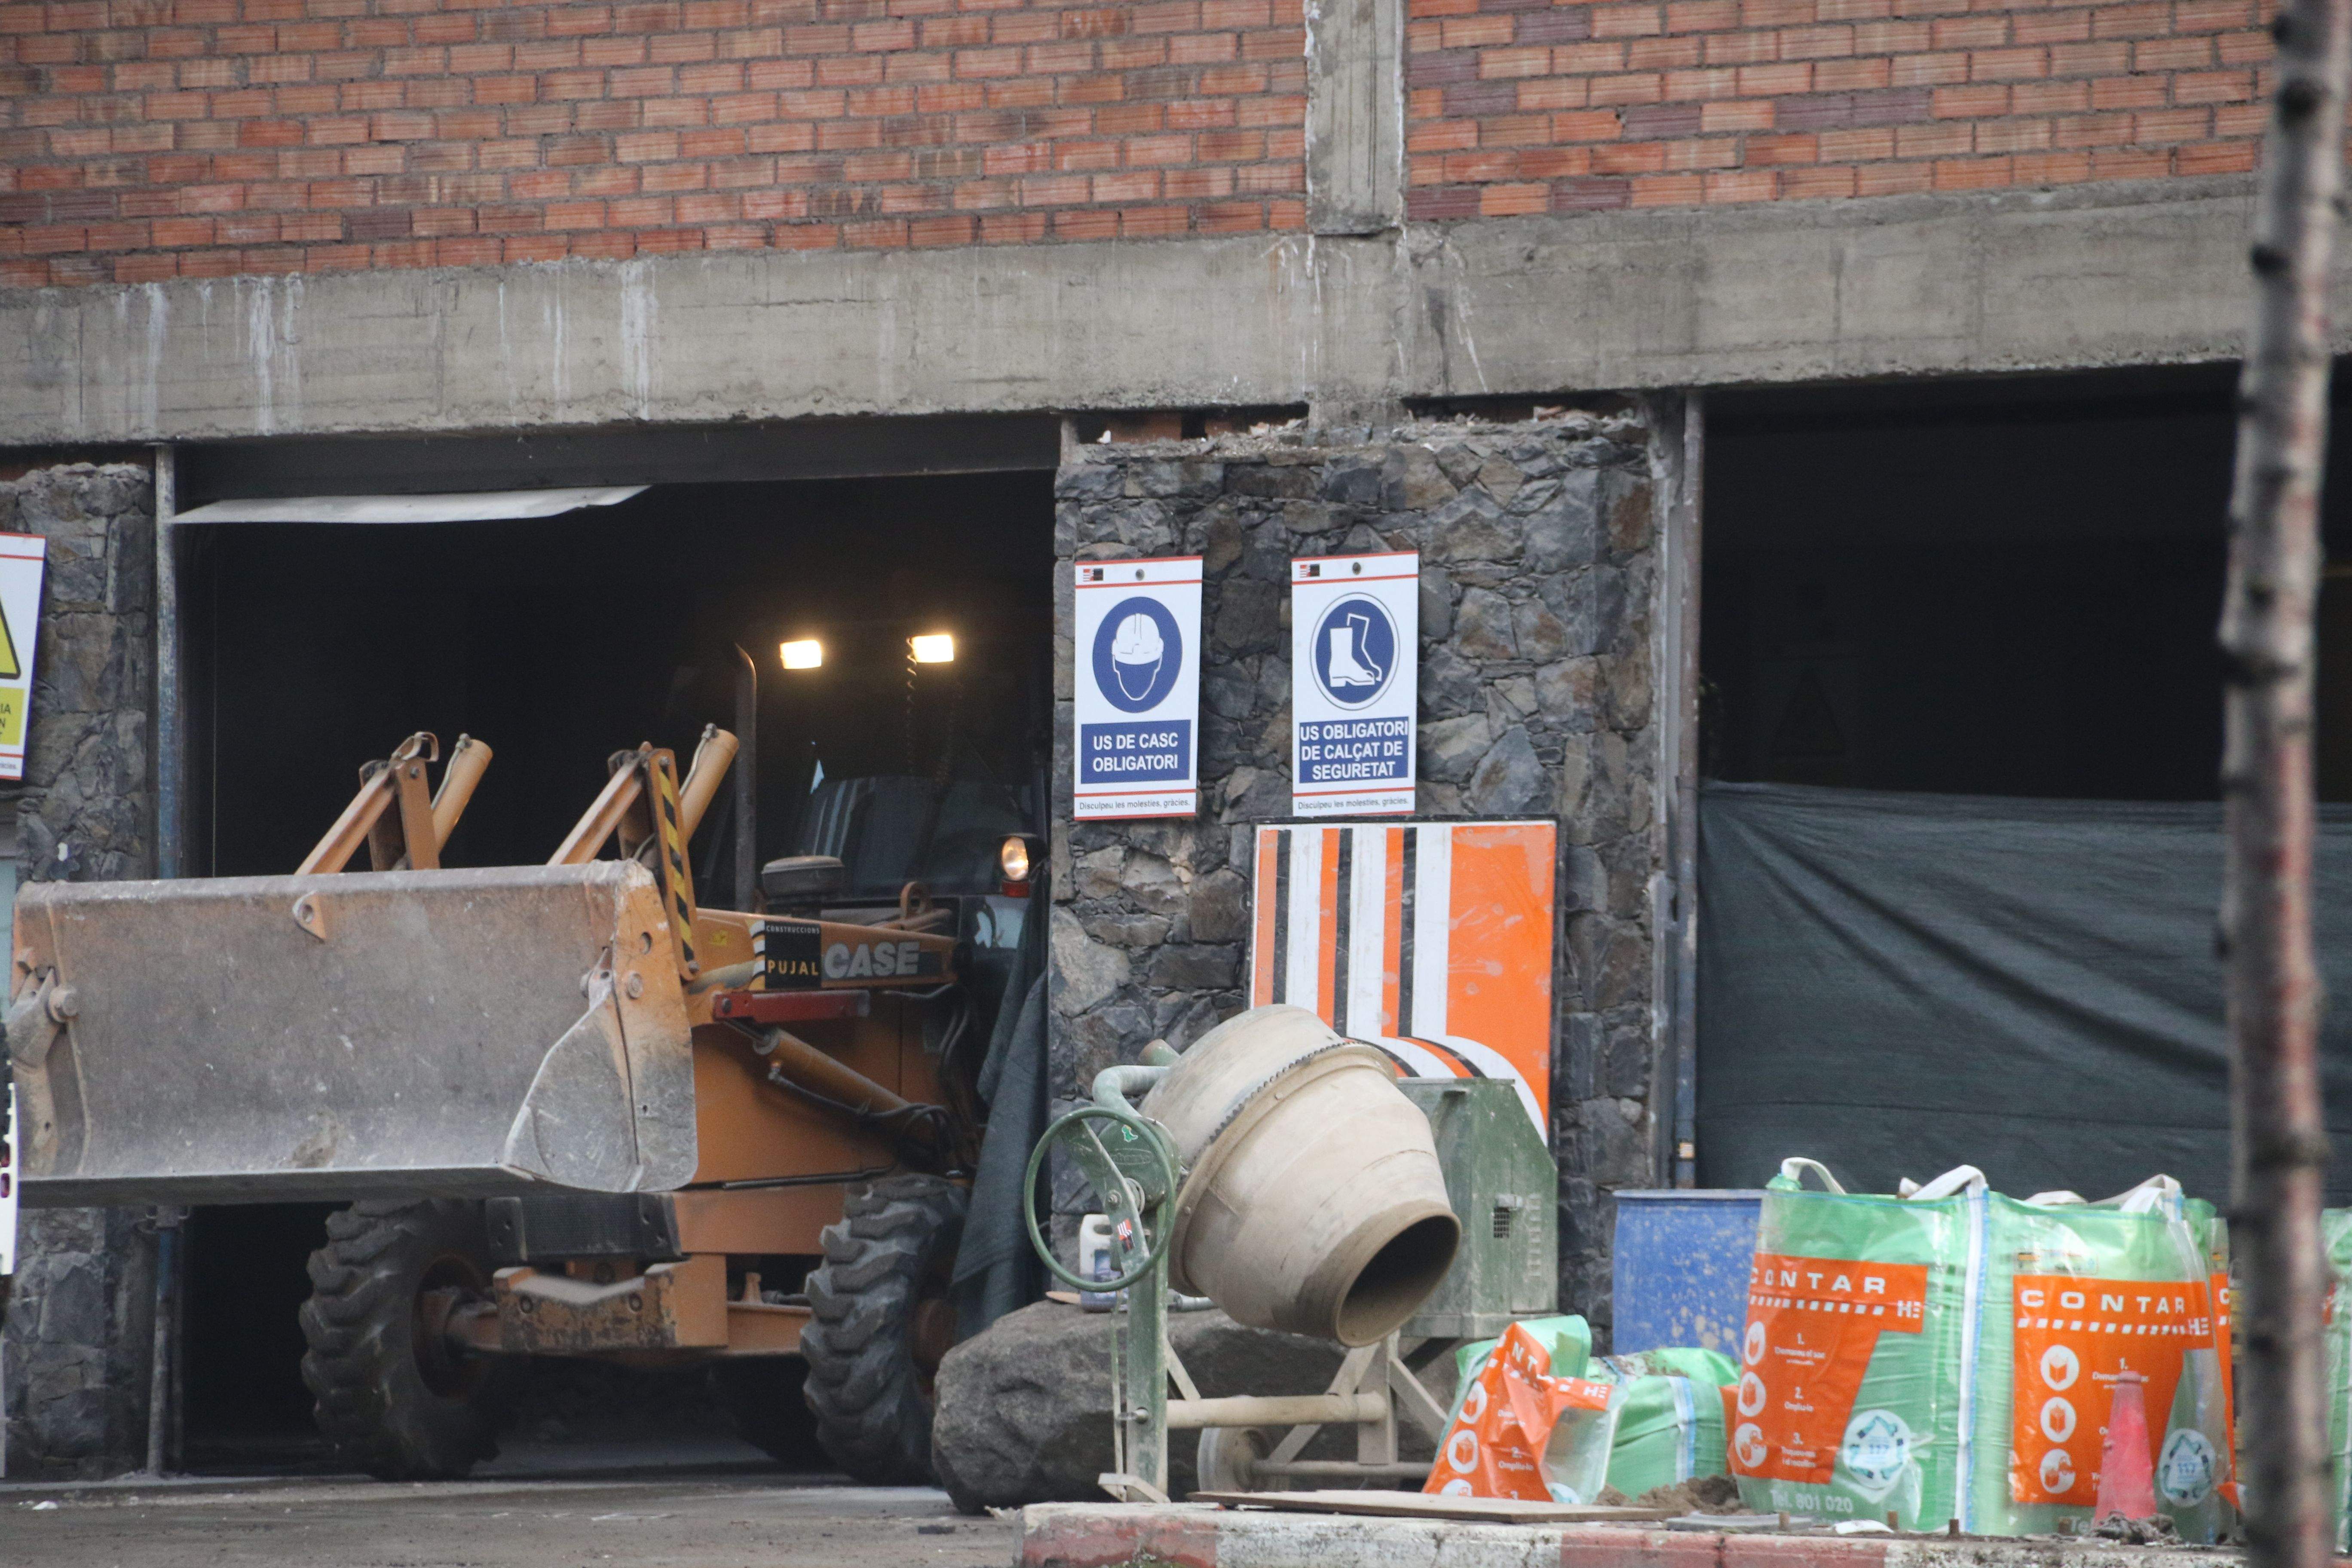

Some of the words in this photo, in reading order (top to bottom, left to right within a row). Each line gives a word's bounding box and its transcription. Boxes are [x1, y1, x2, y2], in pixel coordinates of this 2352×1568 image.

[1300, 726, 1319, 741] US
[1323, 720, 1409, 740] OBLIGATORI
[1093, 735, 1112, 750] US
[1116, 734, 1136, 749] DE
[1139, 732, 1179, 748] CASC
[1302, 745, 1321, 761] DE
[1324, 742, 1381, 761] CALÇAT
[1384, 741, 1403, 756] DE
[1093, 754, 1179, 772] OBLIGATORI
[1312, 761, 1396, 780] SEGURETAT
[1079, 802, 1114, 811] Disculpeu
[1298, 802, 1332, 810] Disculpeu
[766, 925, 820, 934] CONSTRUCCIONS
[767, 959, 819, 975] PUJAL
[824, 941, 920, 979] CASE
[2020, 1289, 2185, 1314] CONTAR
